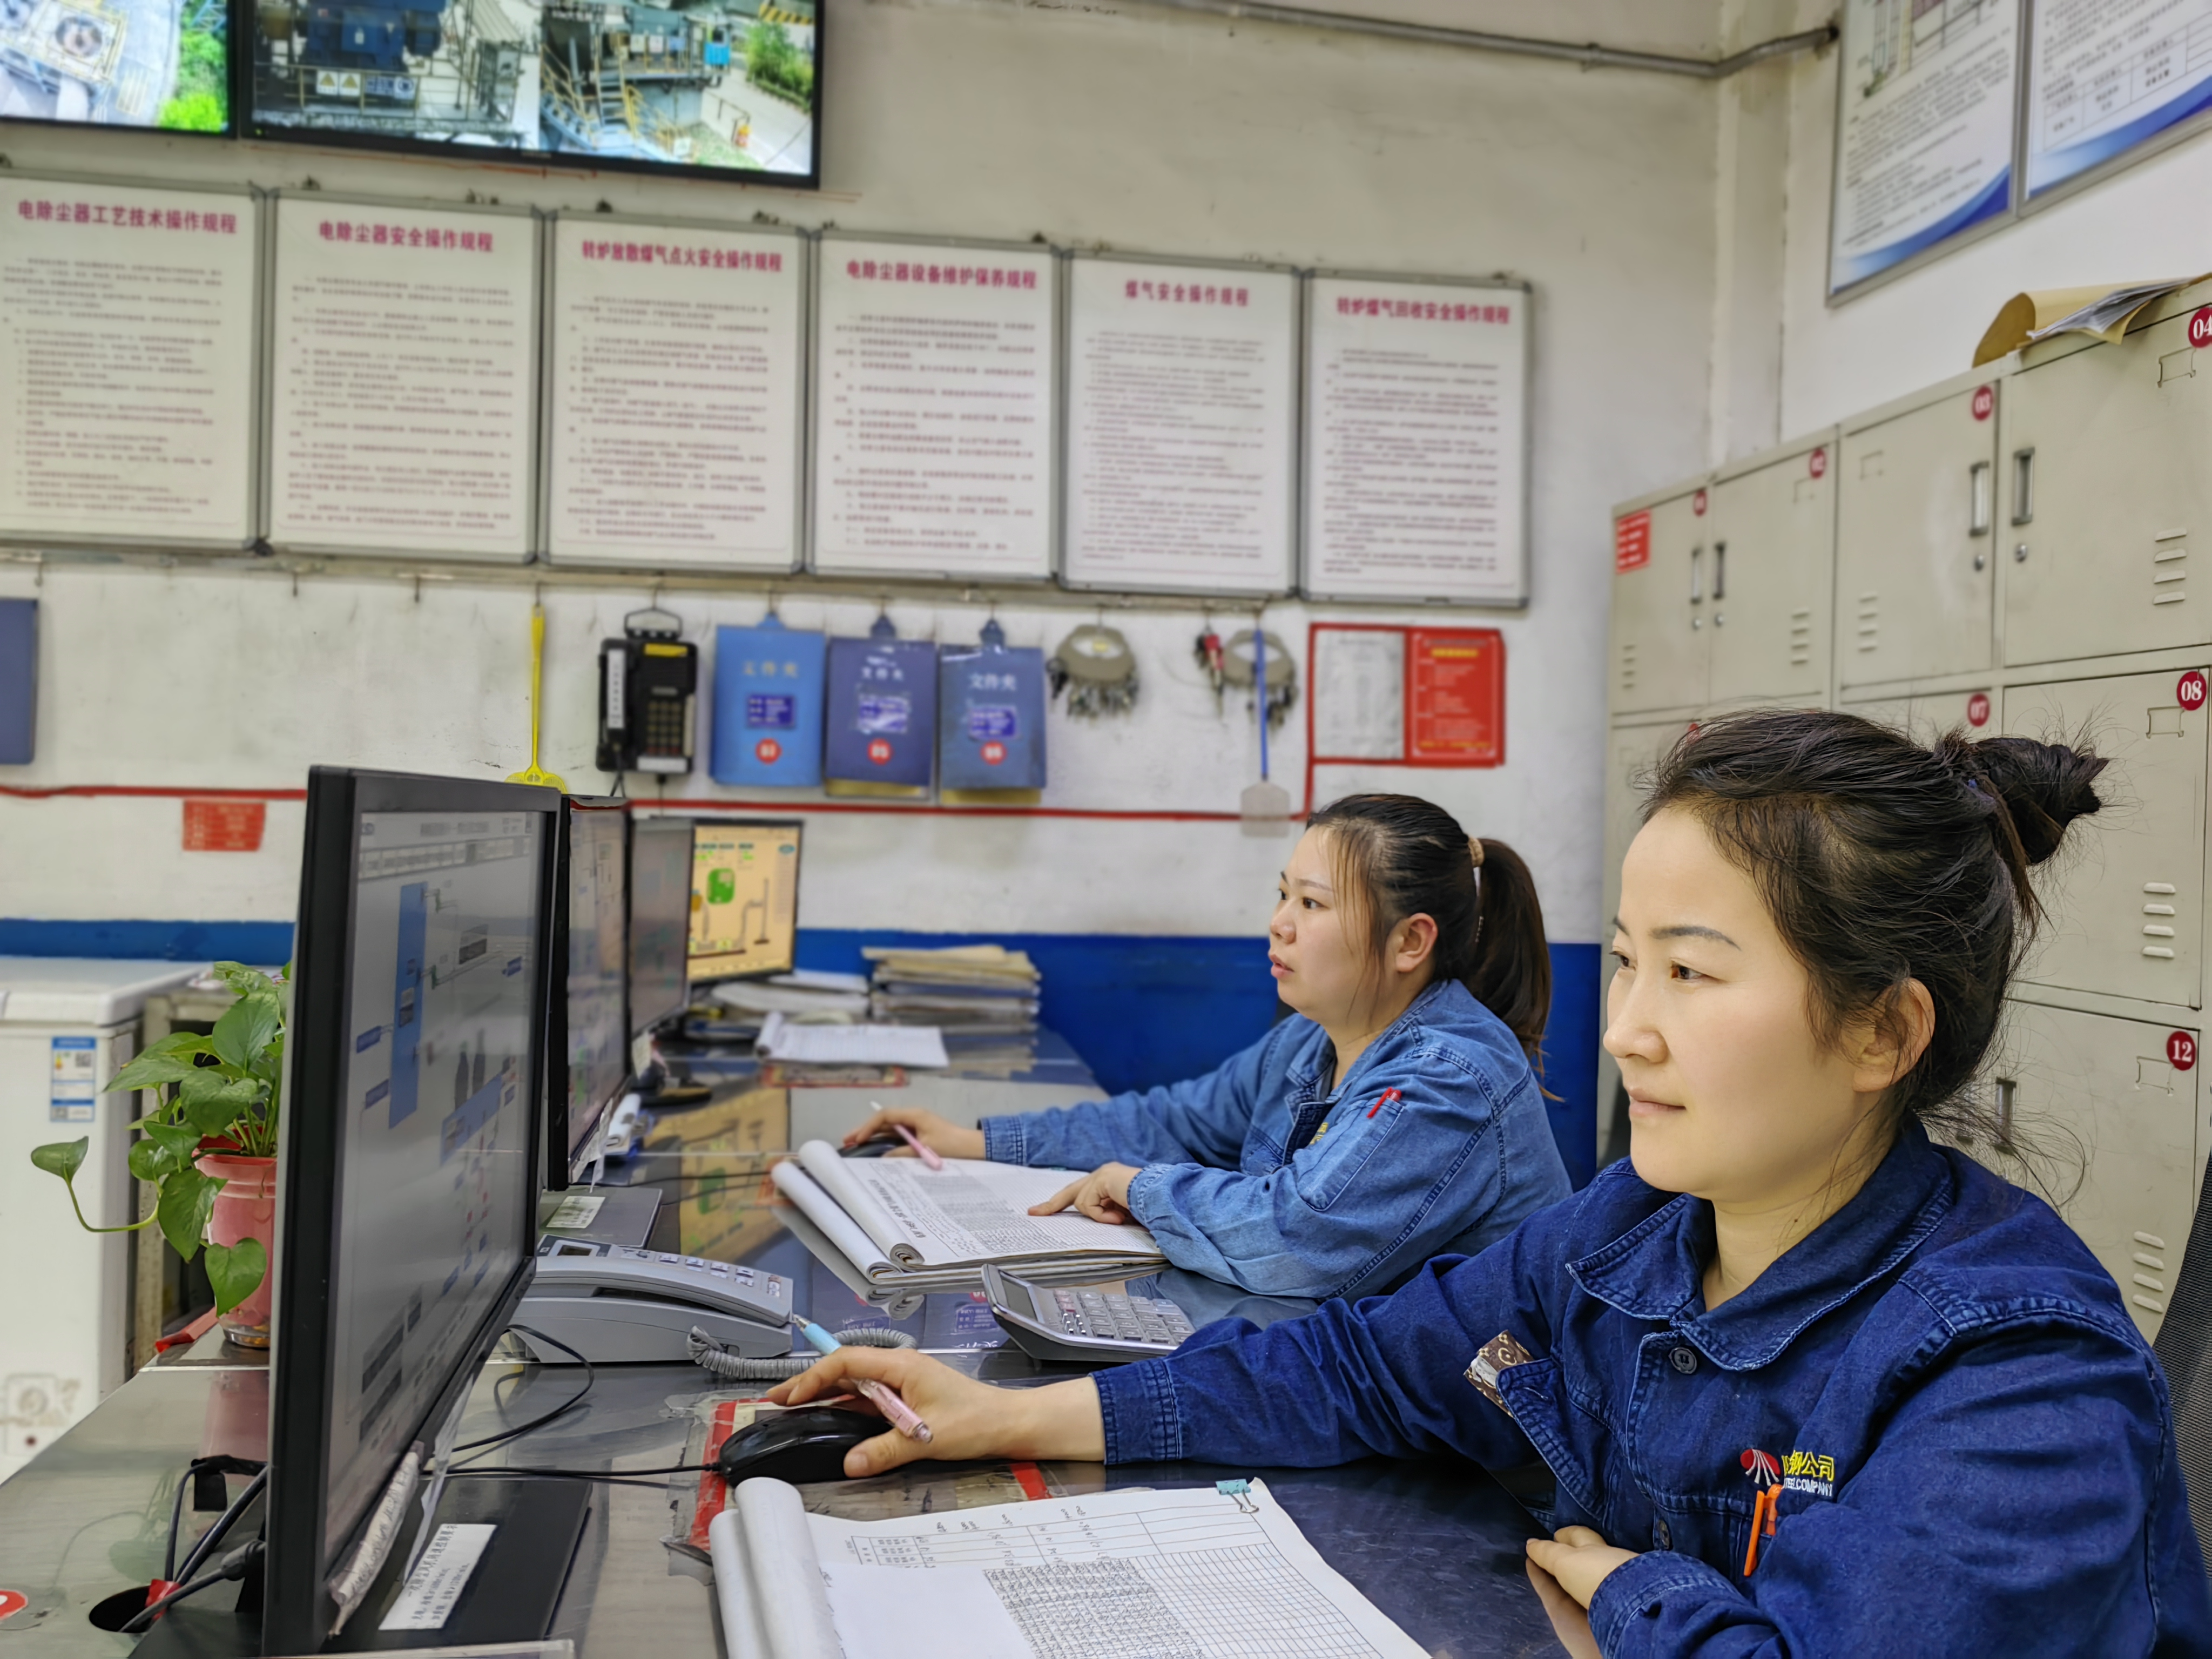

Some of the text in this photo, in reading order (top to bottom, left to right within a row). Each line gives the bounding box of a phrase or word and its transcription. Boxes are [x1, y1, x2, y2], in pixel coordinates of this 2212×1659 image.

[18, 199, 237, 233] 电除尘器工艺技术操作规程
[319, 221, 493, 252] 电除尘器安全操作规程
[582, 240, 782, 272] 转炉放散煤气点火安全操作规程
[847, 260, 1037, 289] 电除尘器设备维护保养规程
[1125, 280, 1249, 307] 煤气安全操作规程
[1337, 296, 1509, 325] 转炉煤气回收安全操作规程
[2193, 315, 2212, 339] 04
[862, 667, 903, 682] 文件夹
[969, 673, 1016, 692] 文件夹
[2181, 680, 2202, 701] 08
[1971, 702, 1987, 719] 07
[2172, 1040, 2192, 1062] 12
